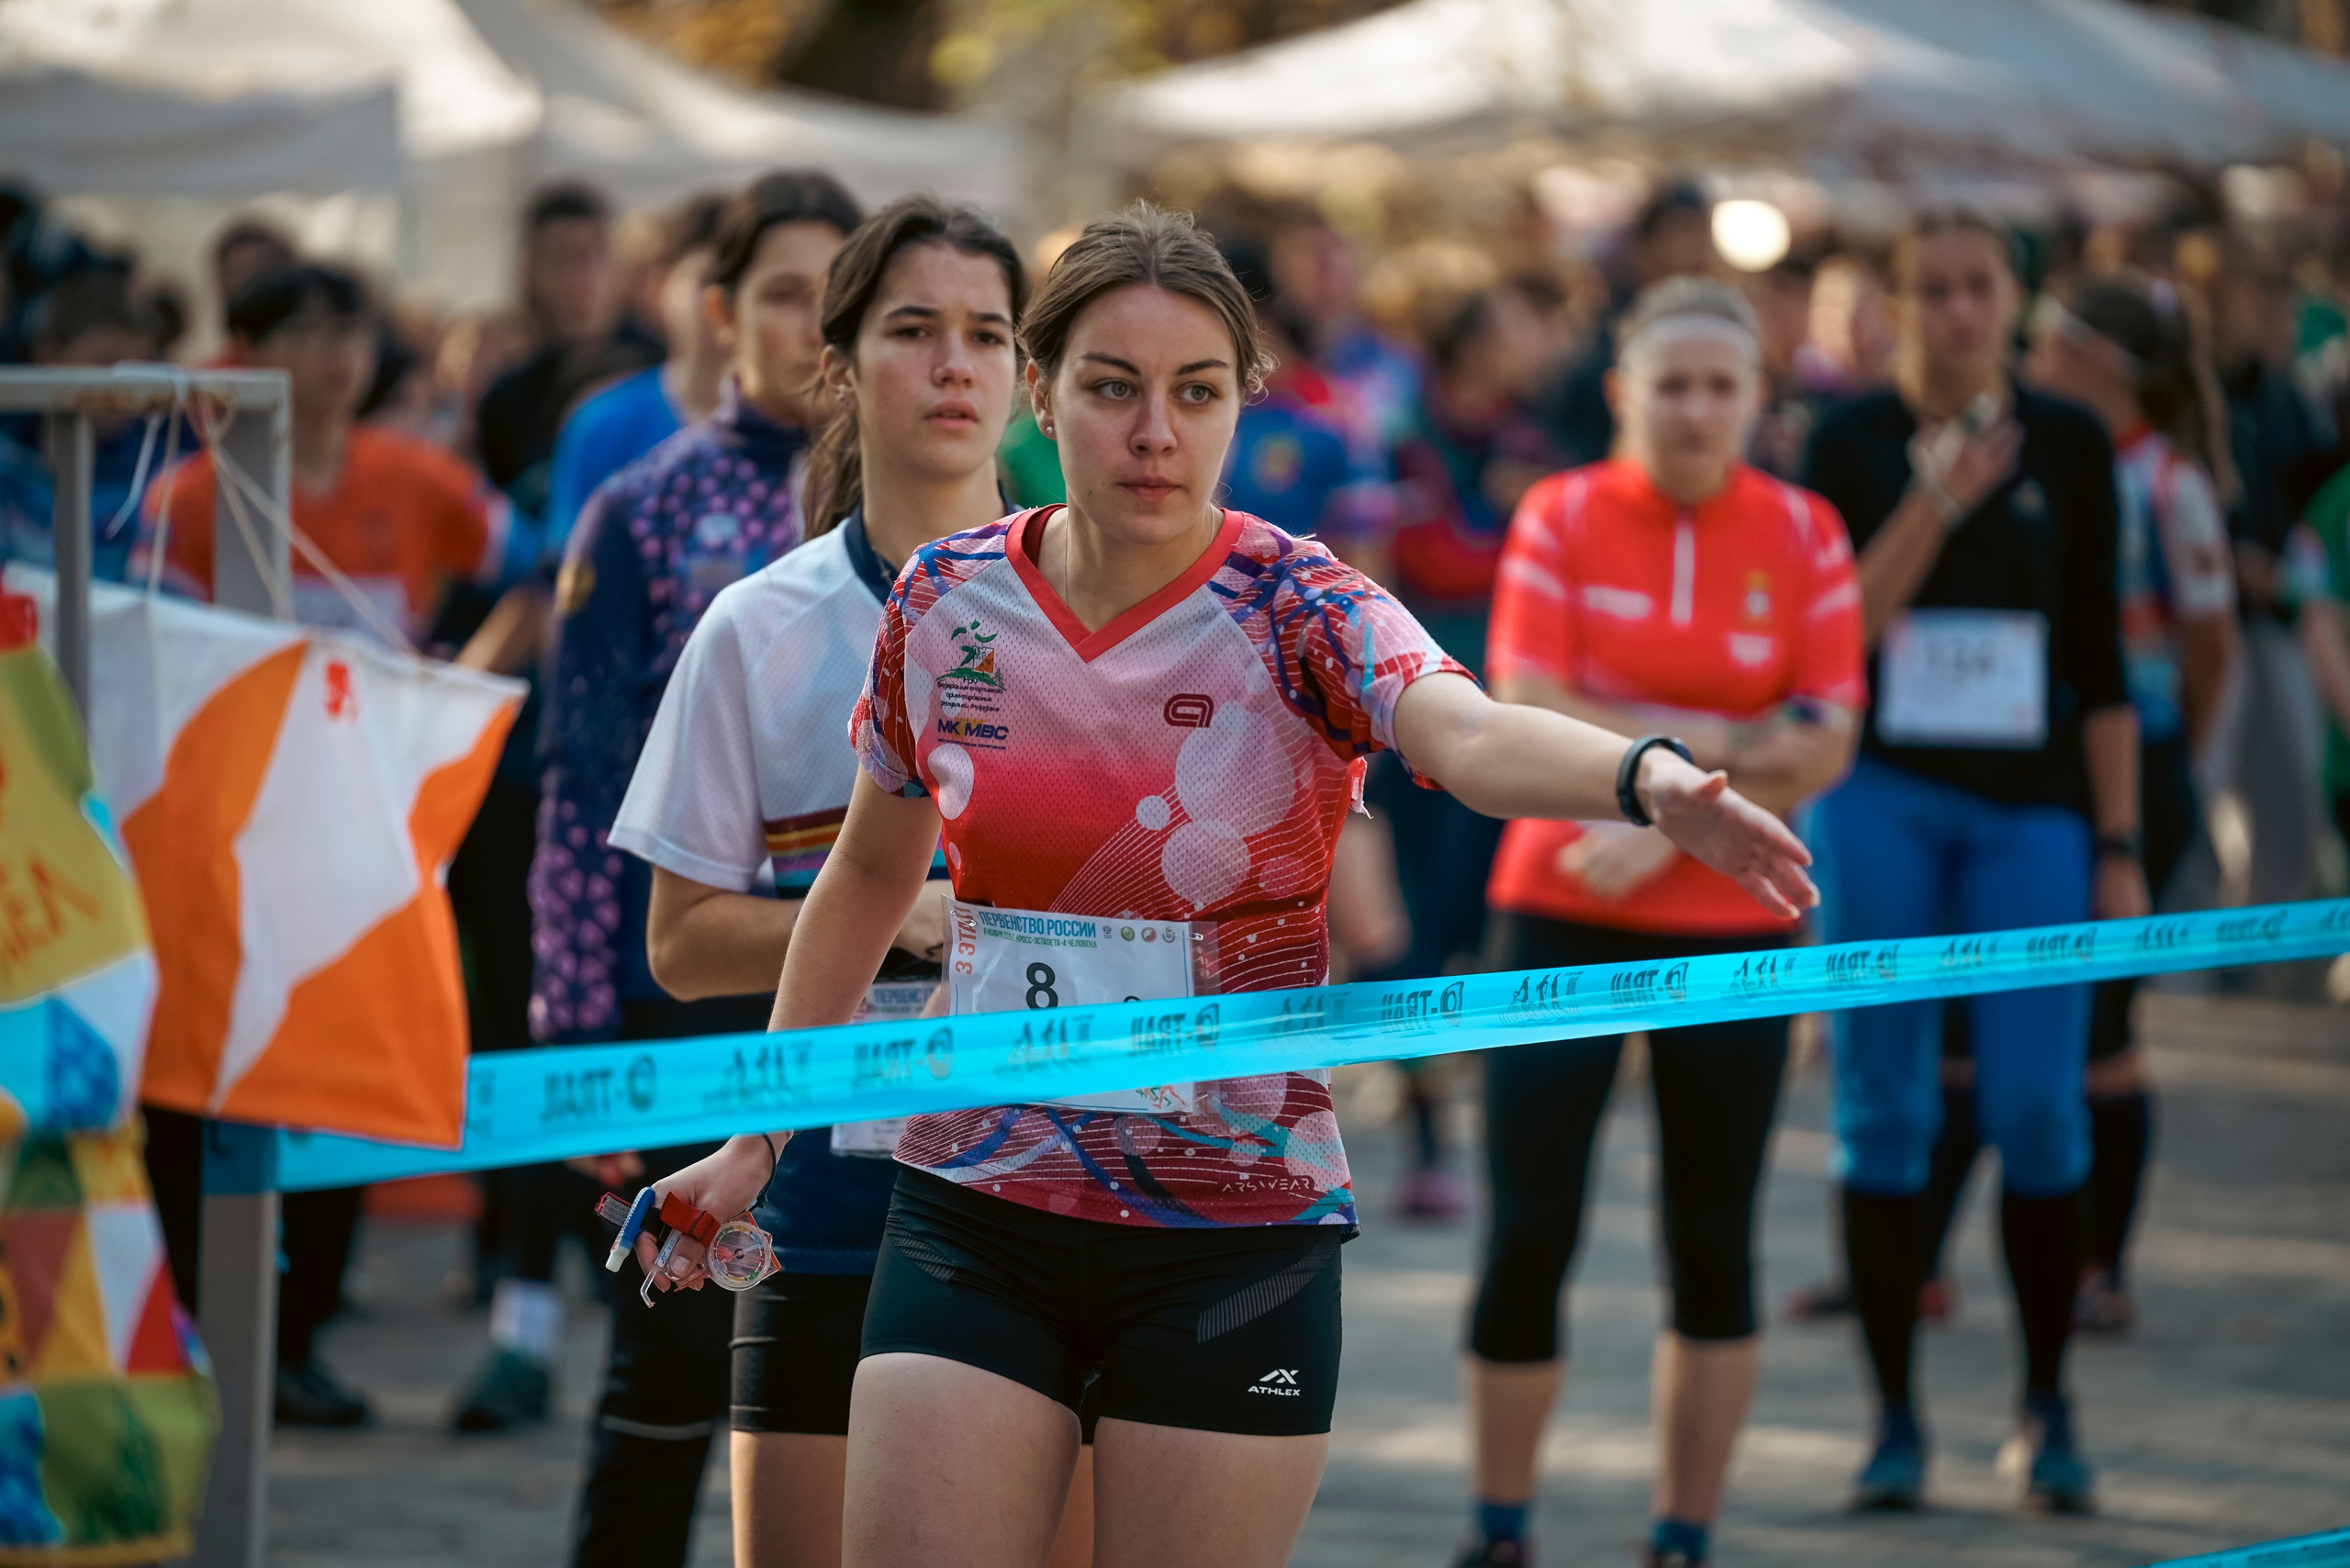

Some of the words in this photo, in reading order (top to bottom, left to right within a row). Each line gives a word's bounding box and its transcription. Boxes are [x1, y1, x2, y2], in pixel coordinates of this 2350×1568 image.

[979, 911, 1044, 935] ПЕРВЕНСТВО
[1047, 919, 1097, 938] РОССИИ
[987, 928, 1003, 937] НОЯБРЯ
[1068, 939, 1098, 949] ЧЕЛОВЕКА
[1025, 962, 1058, 1011] 8
[1248, 1384, 1301, 1396] ATHLEX
